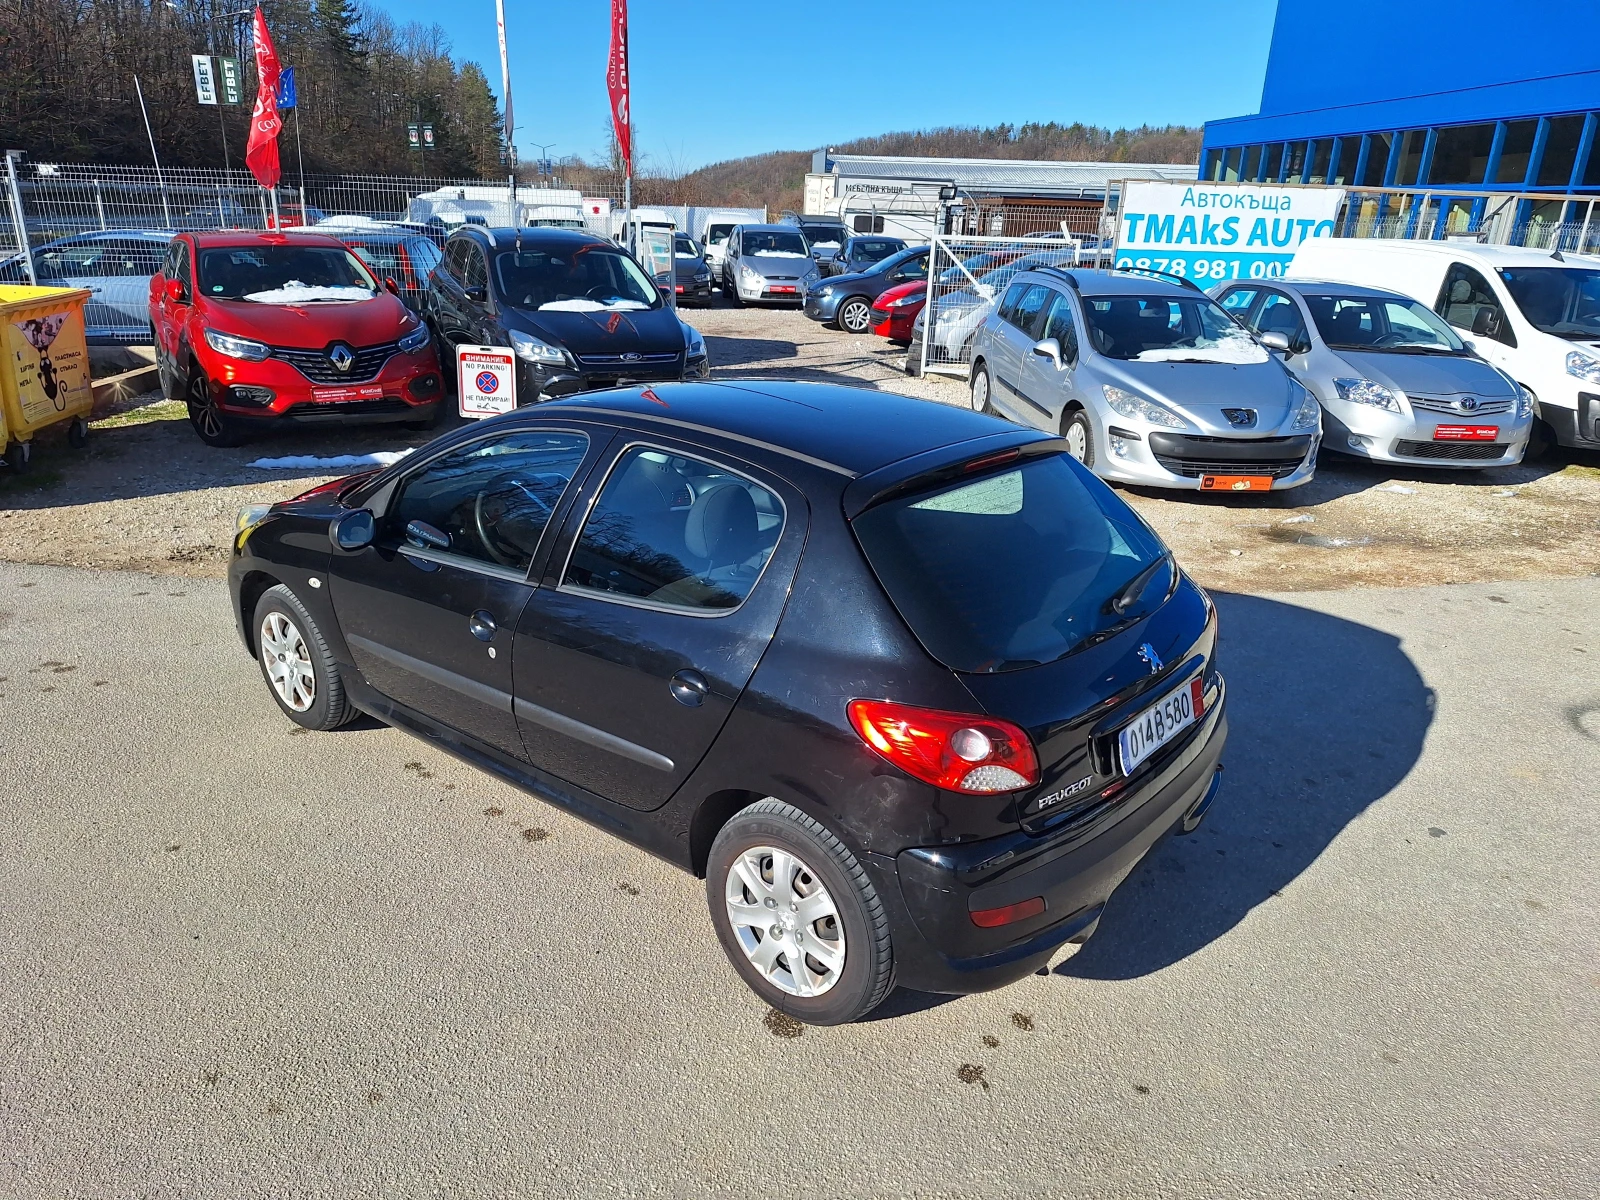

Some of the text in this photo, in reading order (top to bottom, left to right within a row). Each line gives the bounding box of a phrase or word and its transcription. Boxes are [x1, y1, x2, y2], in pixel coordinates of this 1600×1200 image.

[197, 58, 212, 102] EFBET
[224, 59, 239, 103] EFBET
[1180, 187, 1292, 213] Автокъща
[1123, 213, 1240, 246] TMAkS
[1192, 259, 1241, 279] 981
[465, 354, 507, 364] ВНИМАНИЕ!
[476, 363, 508, 372] PARKING!
[476, 395, 511, 403] ПАРКИРАЙ!
[1038, 774, 1093, 809] PEUGEOT
